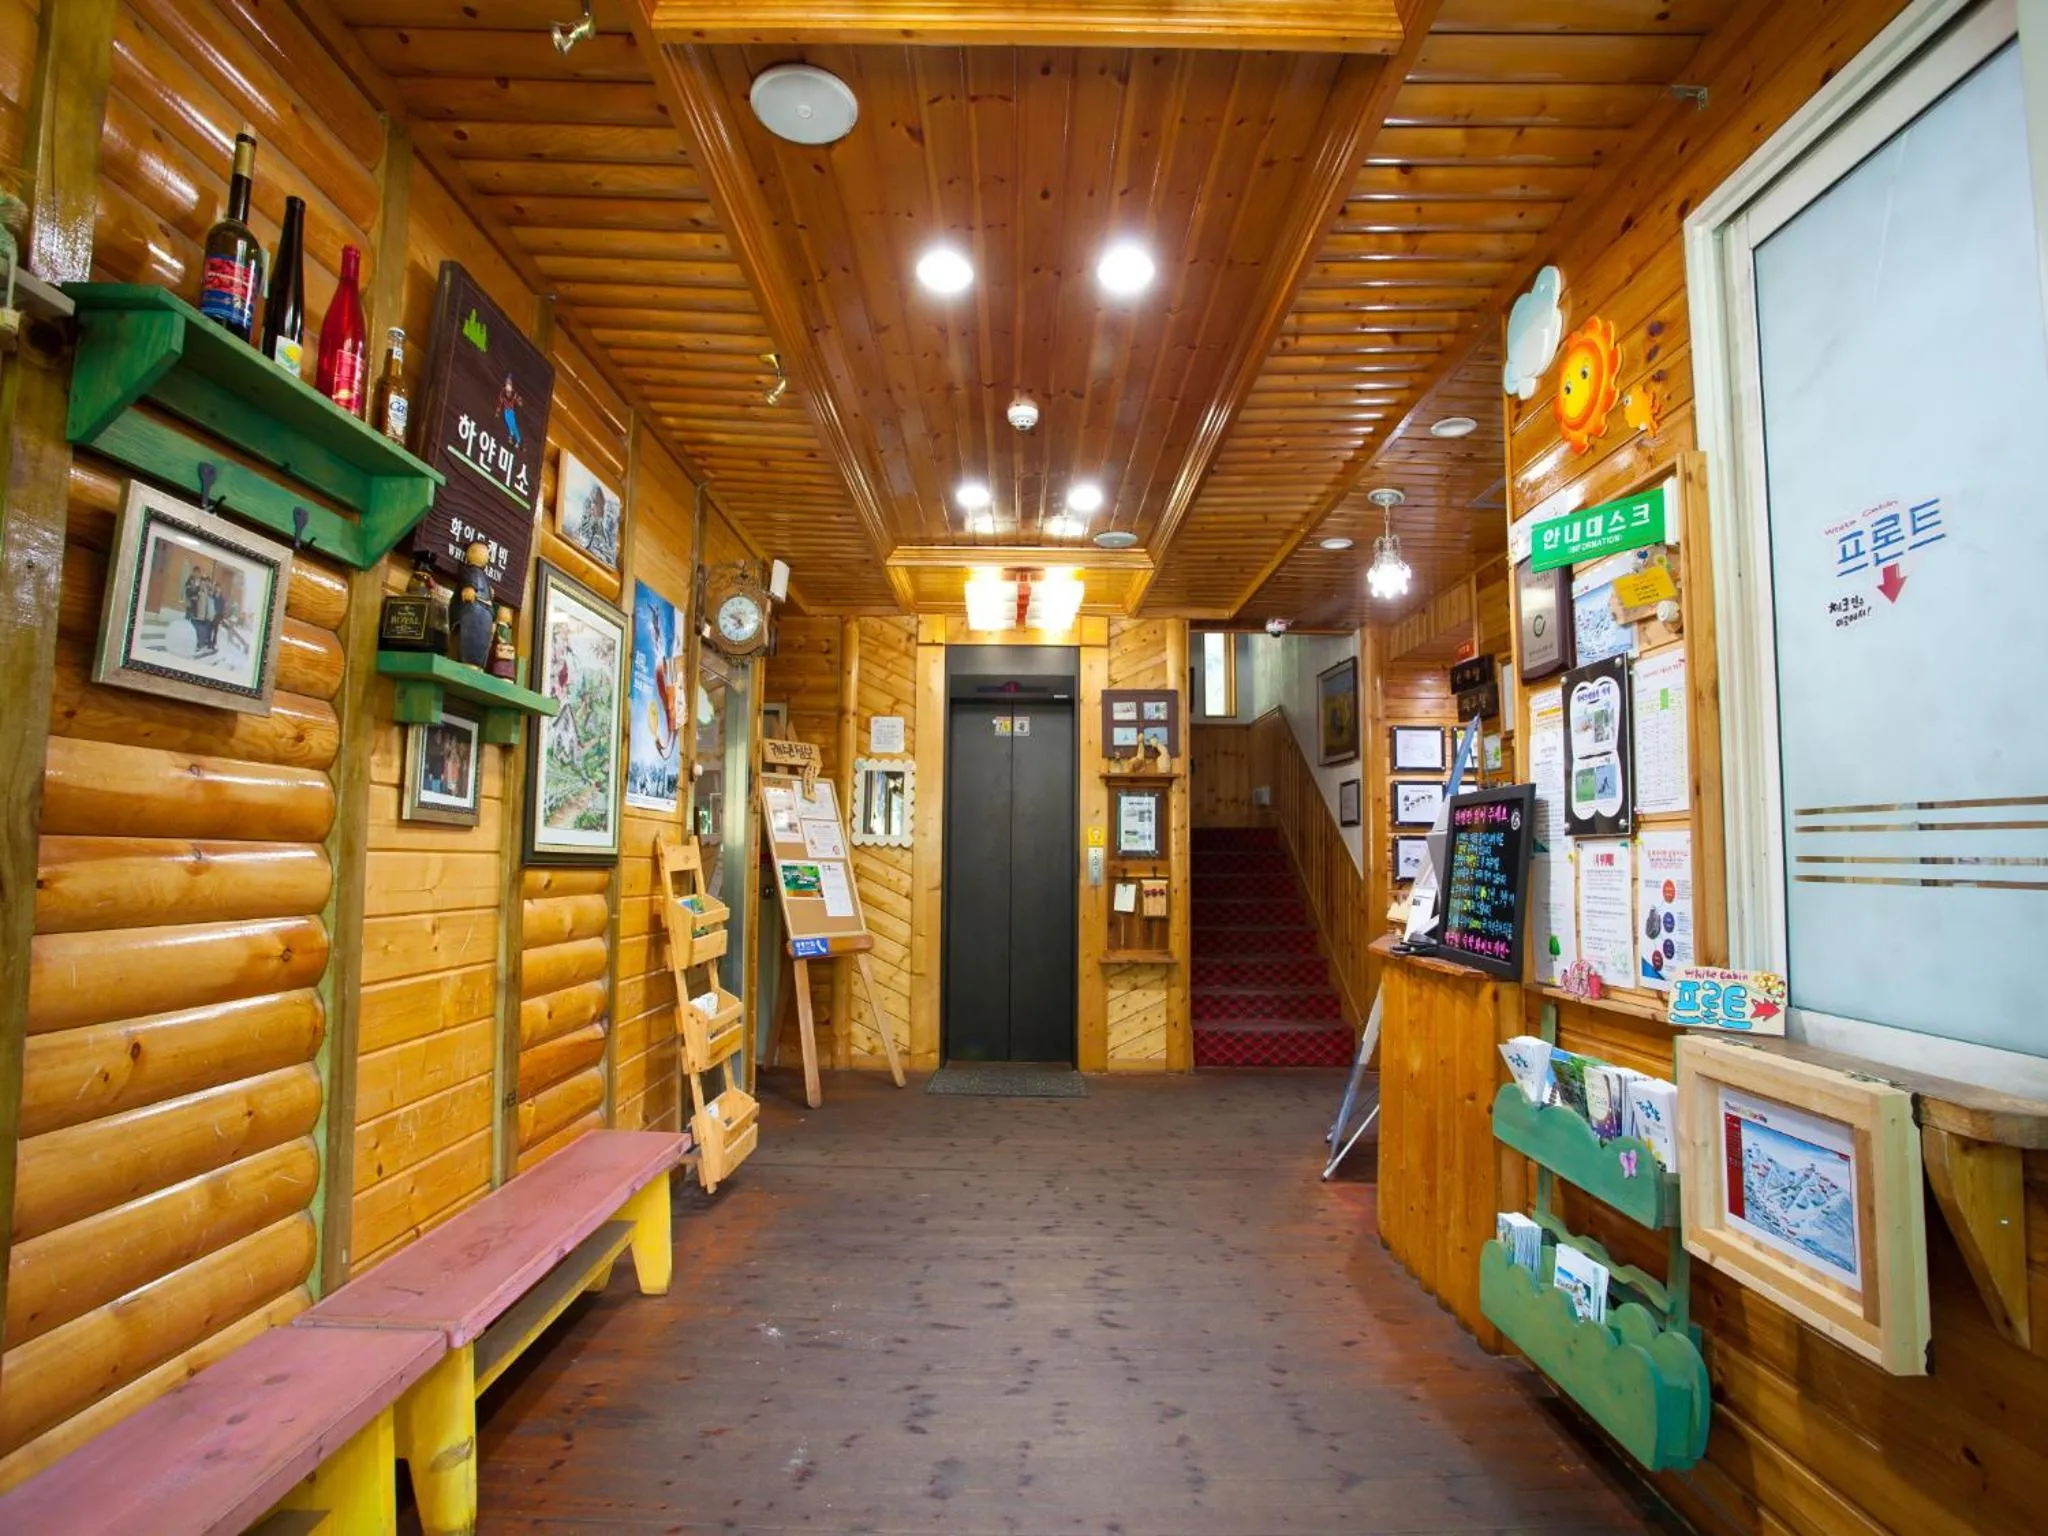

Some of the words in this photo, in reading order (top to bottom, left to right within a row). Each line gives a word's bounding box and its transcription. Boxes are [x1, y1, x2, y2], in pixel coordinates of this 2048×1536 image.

[458, 413, 529, 496] 하얀미소
[1542, 503, 1650, 551] 안내데스크
[1836, 497, 1947, 578] 프론트
[1670, 980, 1753, 1030] 프론트
